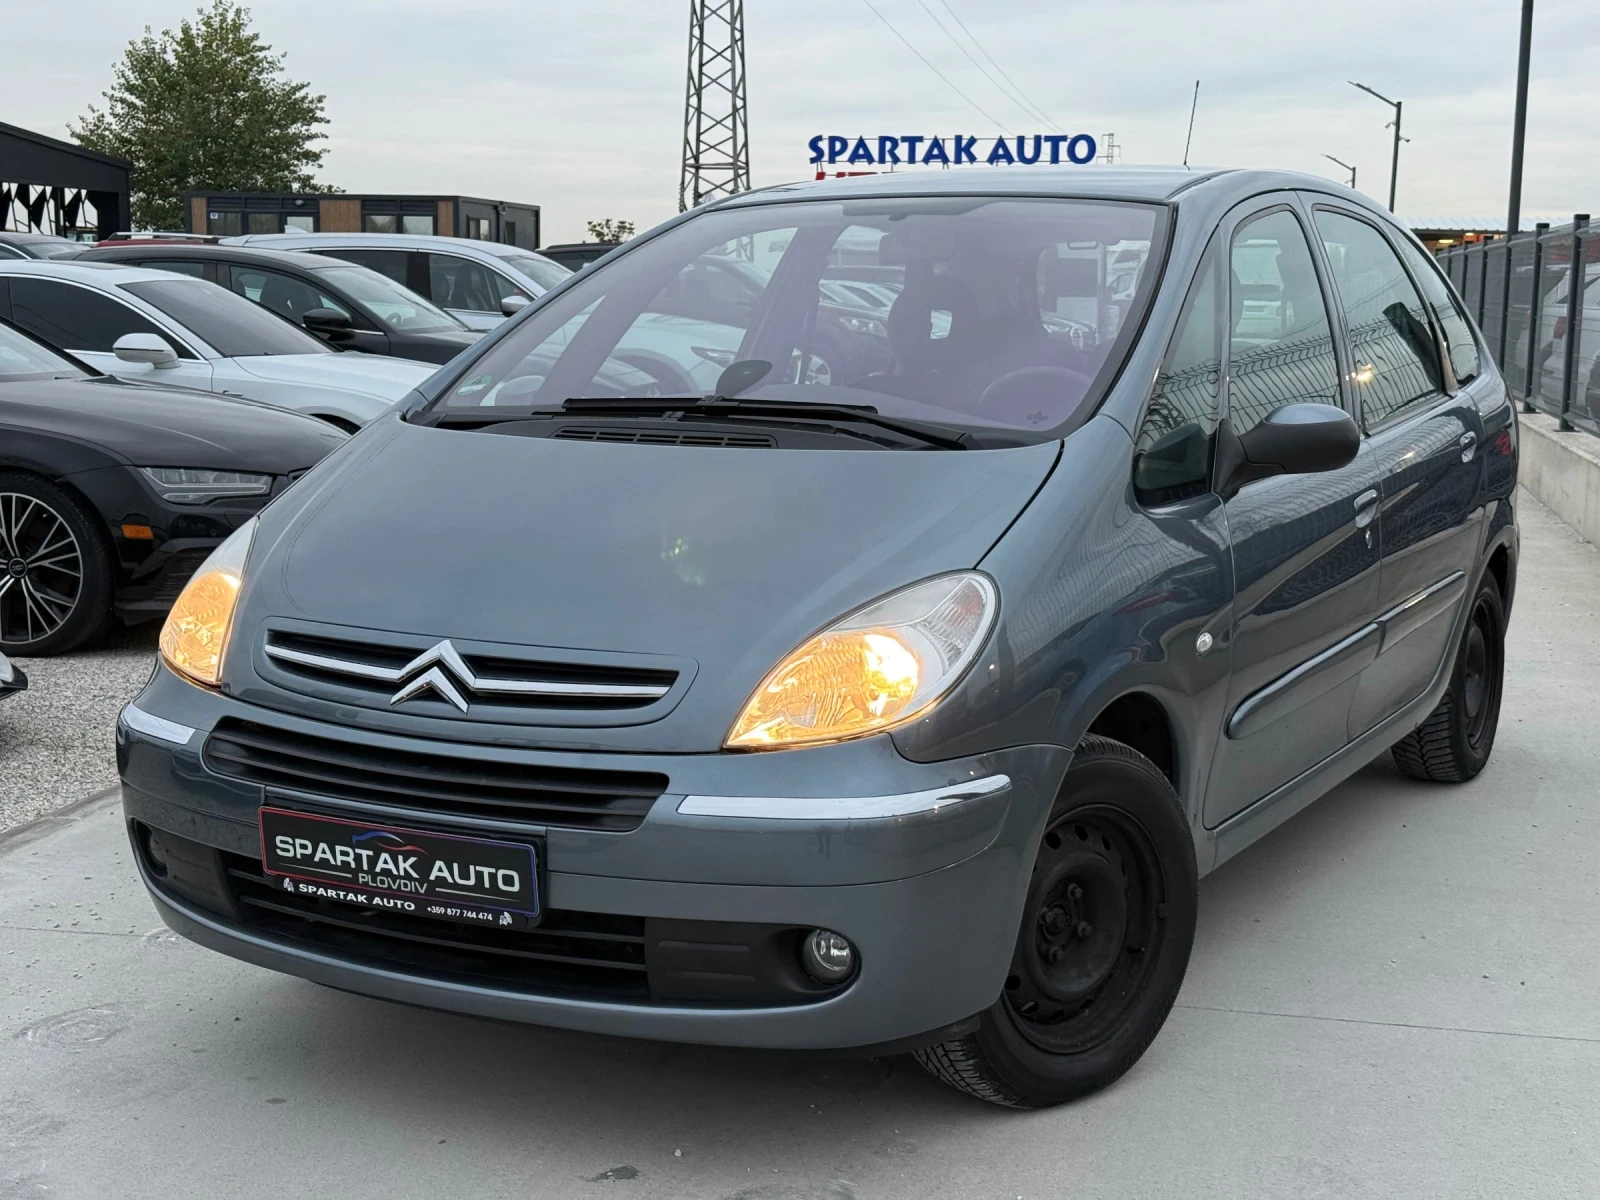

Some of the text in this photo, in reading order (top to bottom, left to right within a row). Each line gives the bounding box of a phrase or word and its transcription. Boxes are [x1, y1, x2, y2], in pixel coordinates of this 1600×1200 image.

[808, 134, 1097, 165] SPARTAK AUTO
[275, 835, 520, 892] SPARTAK AUTO
[358, 873, 428, 894] PLOVDIV
[298, 883, 493, 921] SPARTAK AUTO +359 877 744 474
